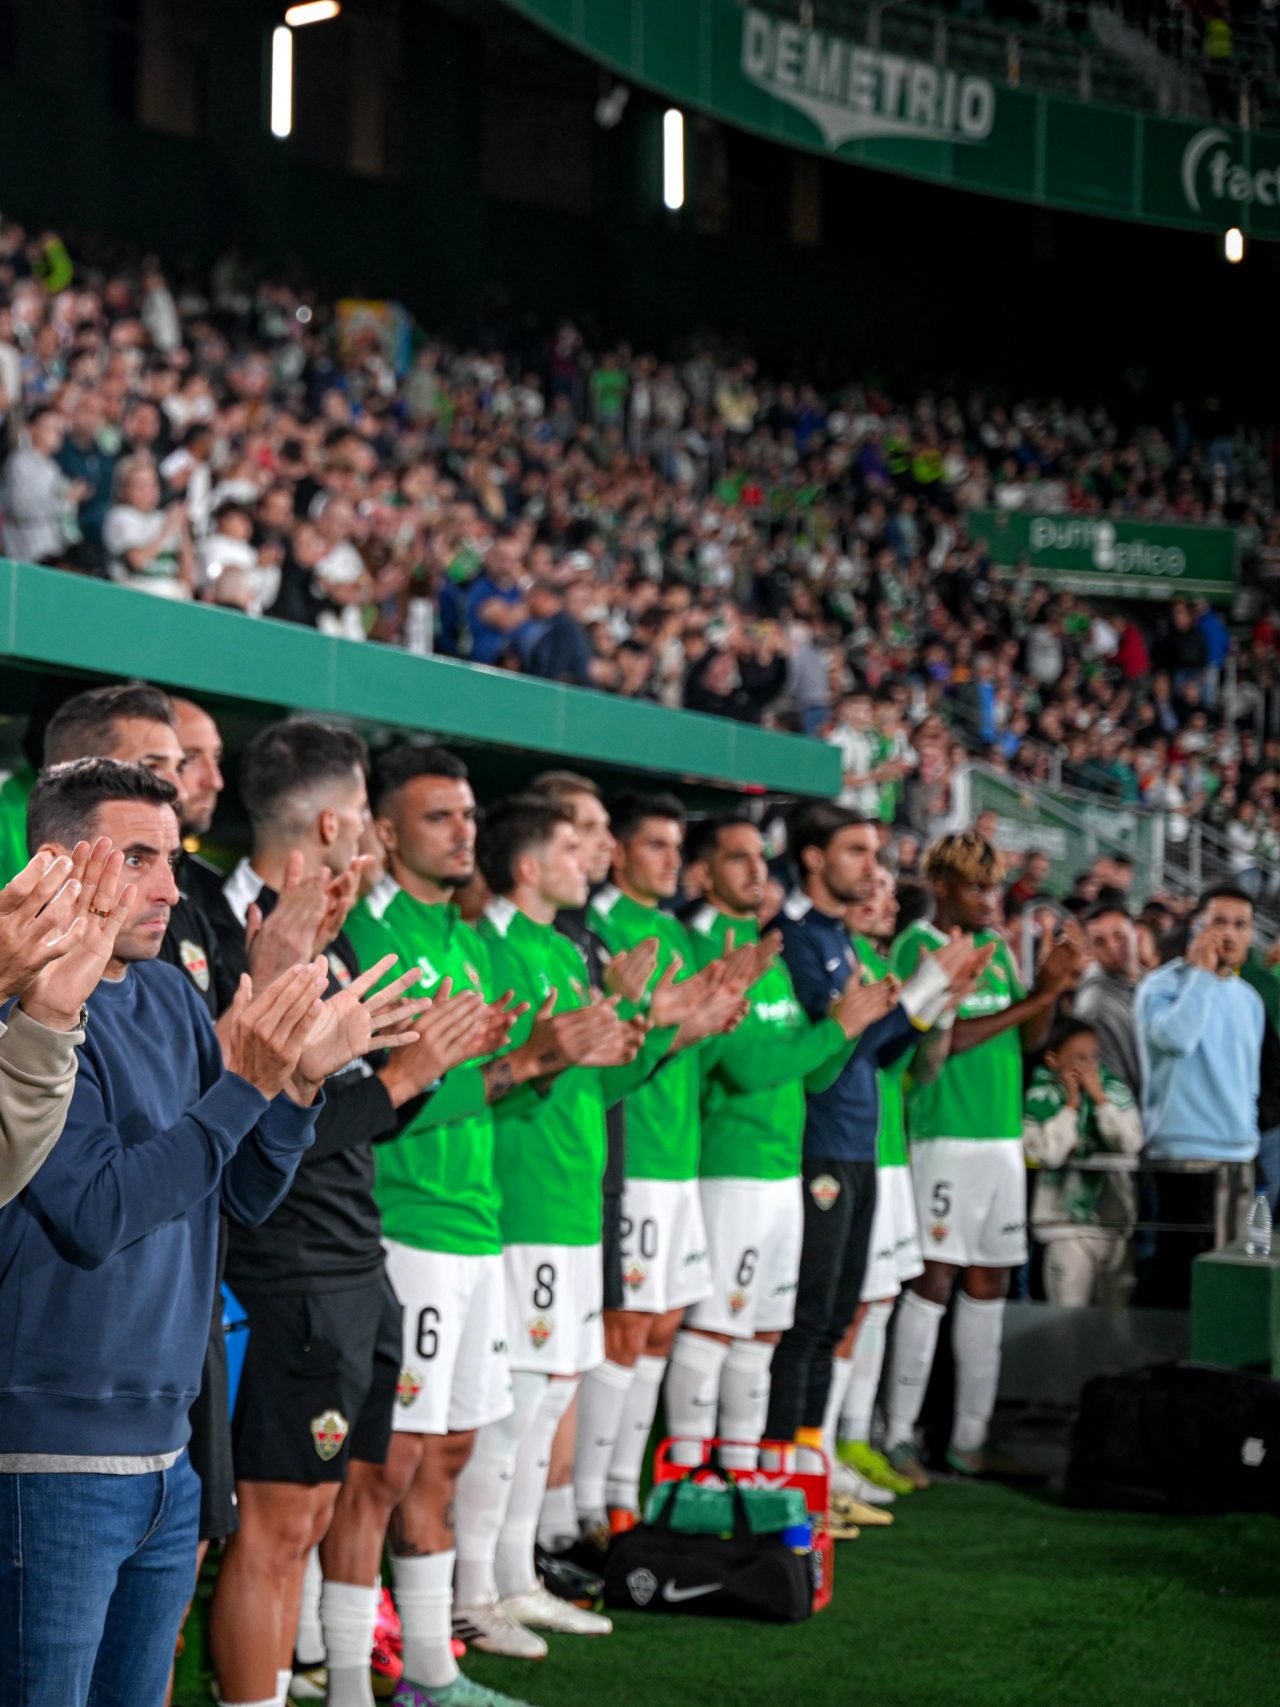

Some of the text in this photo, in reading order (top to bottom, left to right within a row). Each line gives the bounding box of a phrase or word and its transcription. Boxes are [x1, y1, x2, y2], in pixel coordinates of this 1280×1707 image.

[741, 5, 996, 140] DEMETRIO
[931, 1180, 953, 1219] 5
[533, 1262, 556, 1310] 8
[736, 1247, 759, 1288] 6
